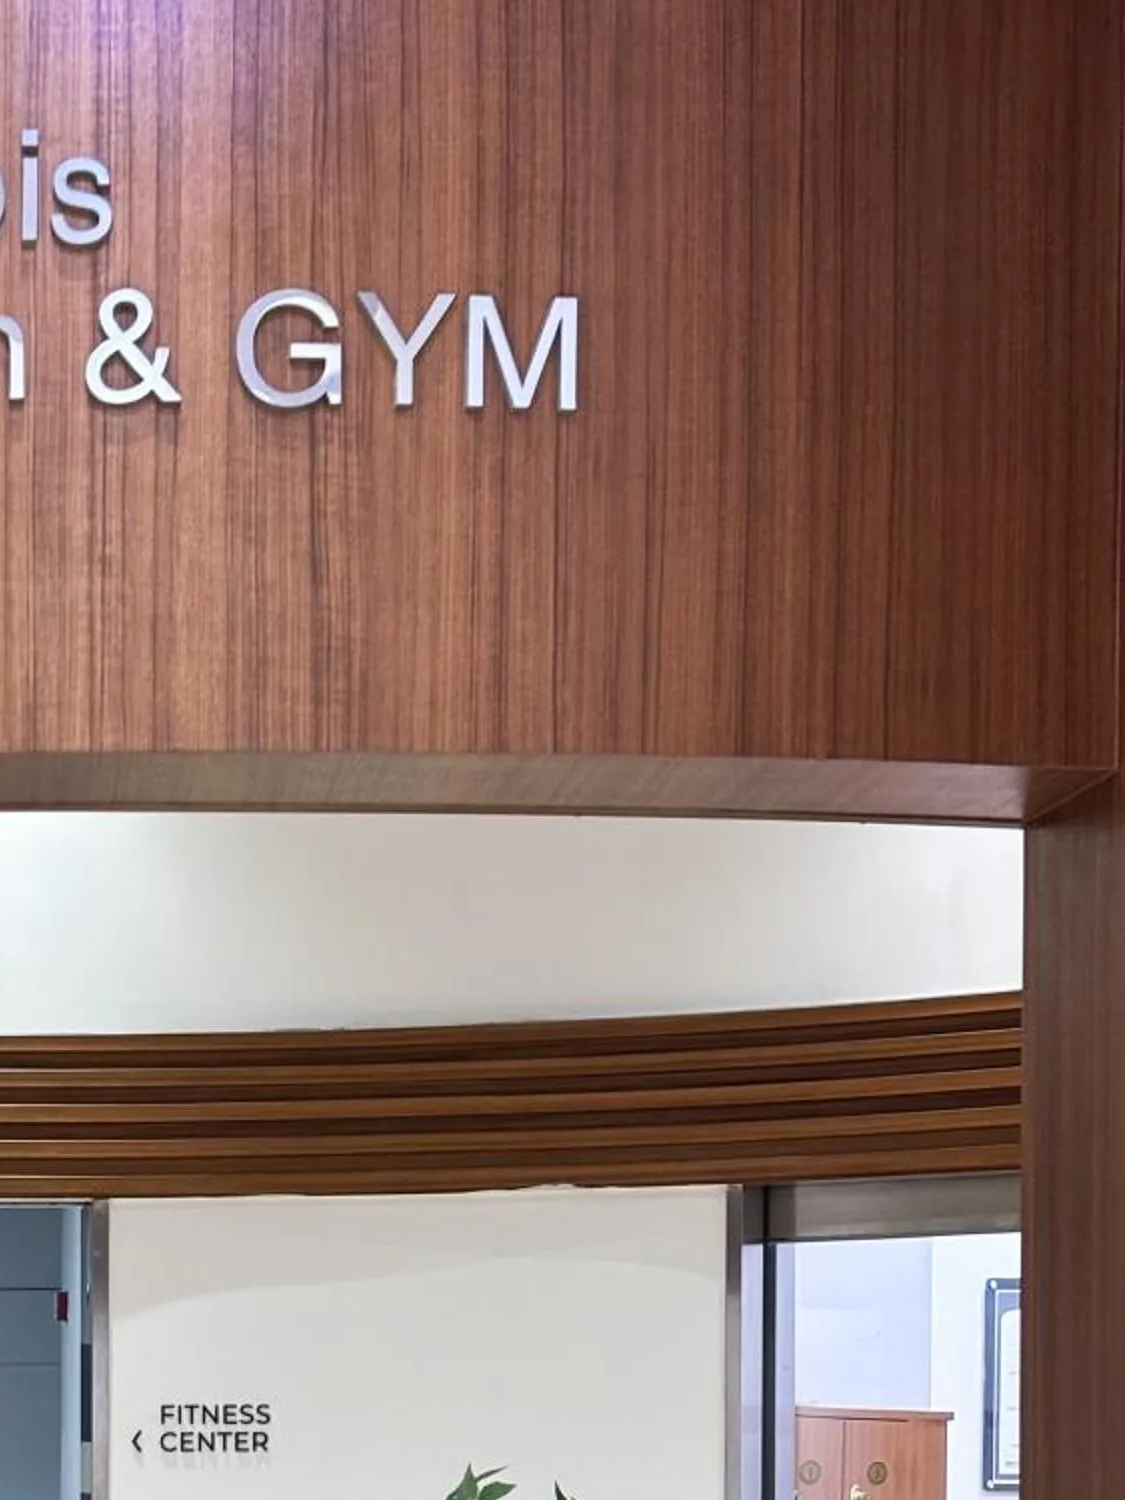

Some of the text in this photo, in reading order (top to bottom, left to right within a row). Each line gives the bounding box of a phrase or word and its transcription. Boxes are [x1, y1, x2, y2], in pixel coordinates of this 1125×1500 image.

[85, 286, 183, 405] &
[235, 287, 579, 412] GYM
[159, 1404, 272, 1425] FITNESS
[159, 1431, 270, 1453] CENTER
